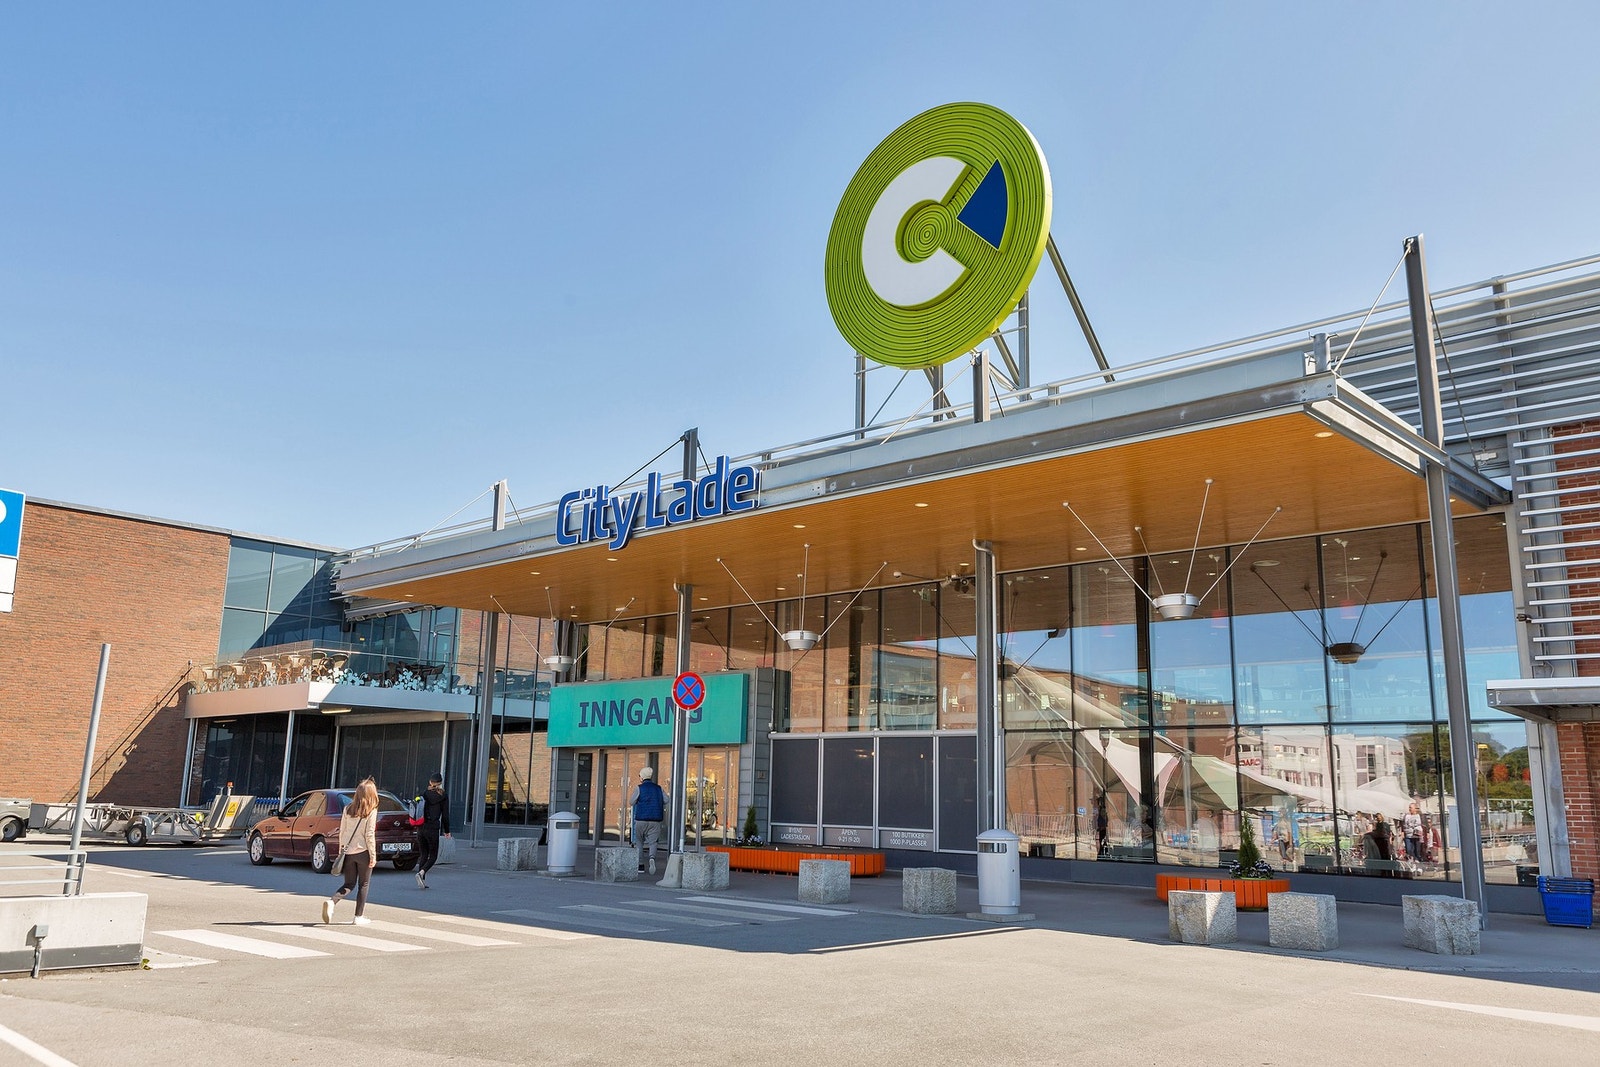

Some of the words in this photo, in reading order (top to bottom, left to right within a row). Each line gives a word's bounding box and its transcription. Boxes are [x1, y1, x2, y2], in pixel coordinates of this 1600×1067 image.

[556, 485, 643, 550] City
[645, 455, 762, 530] Lade
[780, 833, 811, 841] LADESTASJON
[902, 839, 928, 847] P-PLASSER
